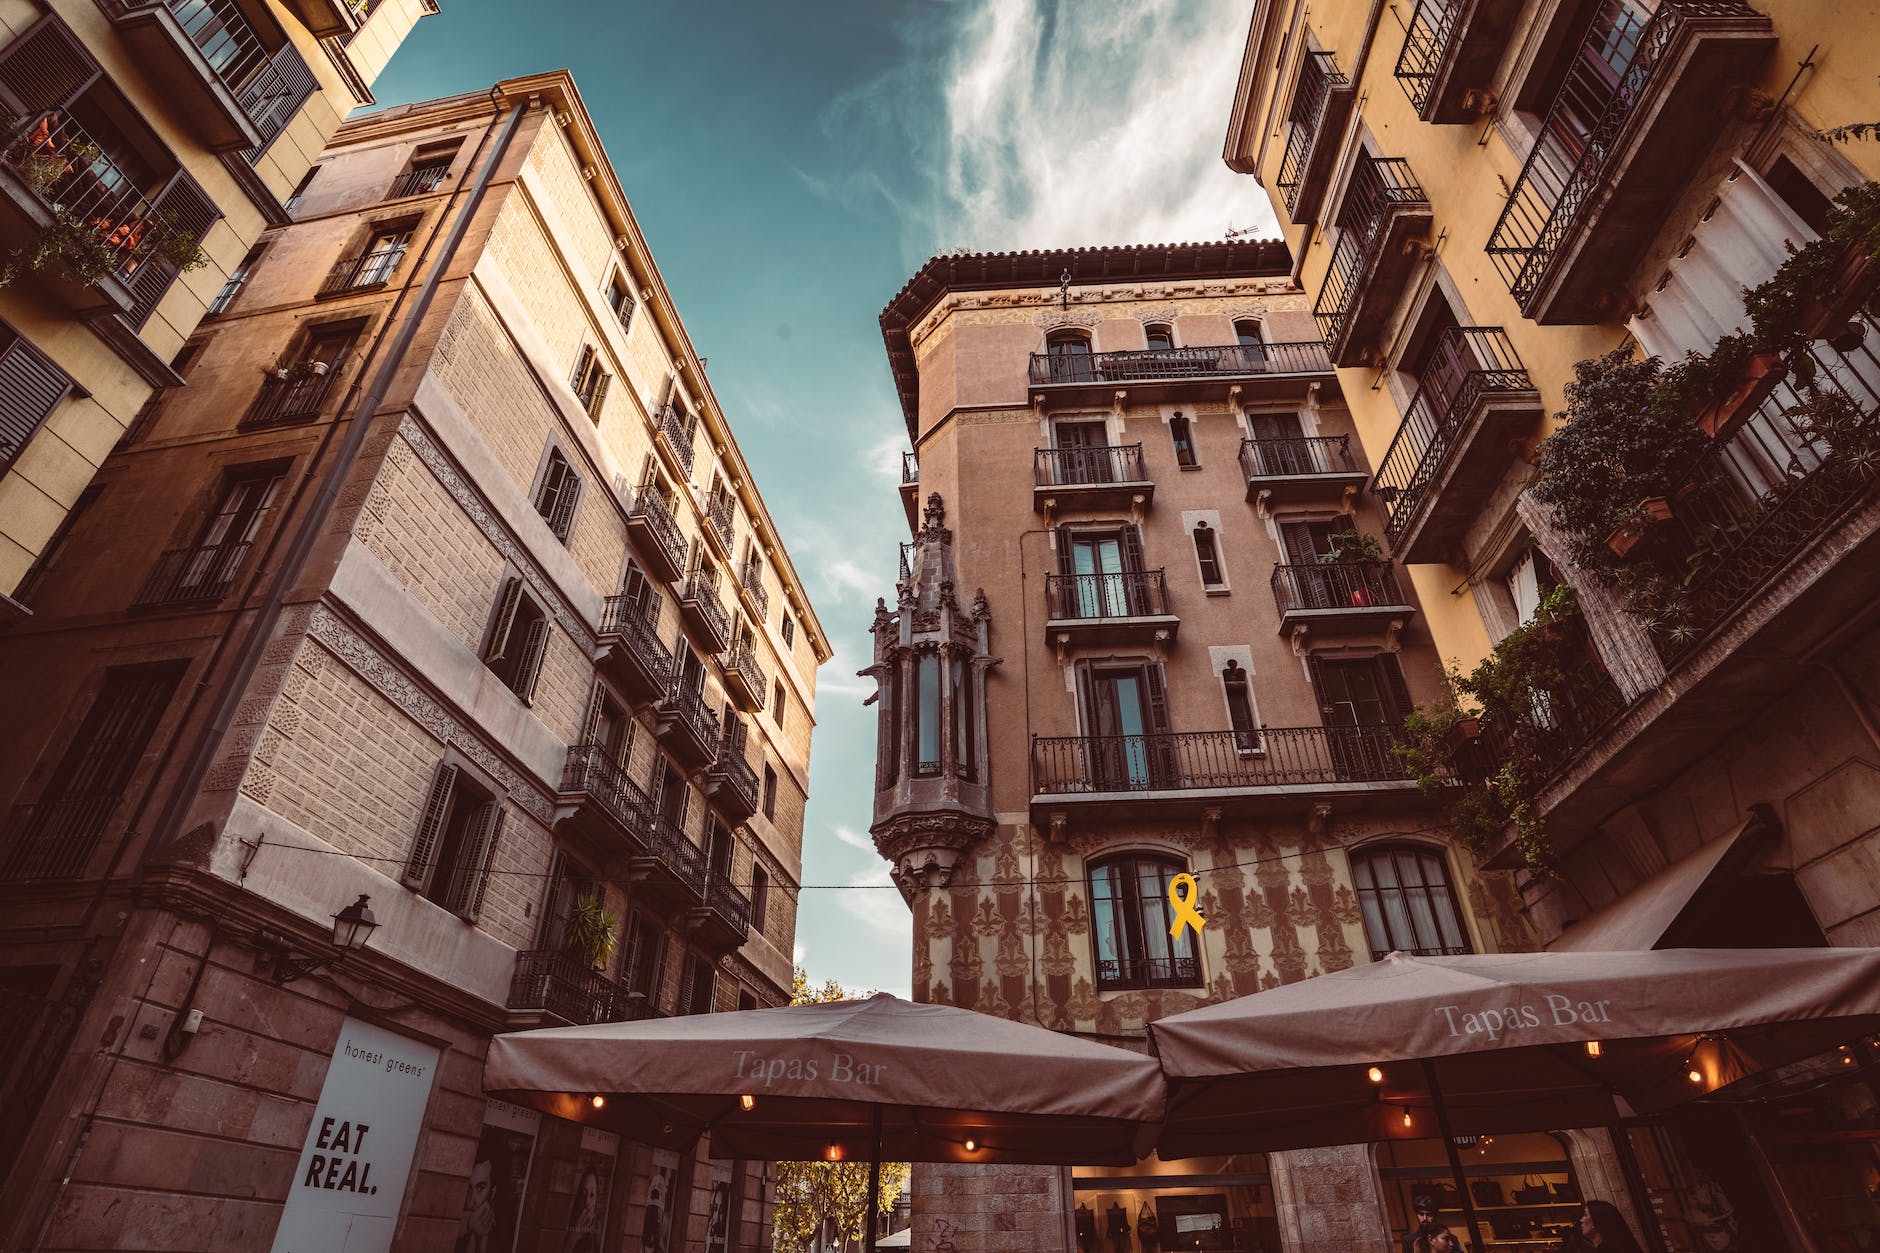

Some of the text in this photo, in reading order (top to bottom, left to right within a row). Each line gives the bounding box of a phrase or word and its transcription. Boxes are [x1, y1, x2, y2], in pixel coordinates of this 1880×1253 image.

[1434, 994, 1613, 1042] Tapas Bar
[343, 1038, 383, 1065] honest
[732, 1050, 888, 1088] Tapas Bar
[316, 1117, 369, 1155] EAT
[304, 1154, 377, 1195] REAL.
